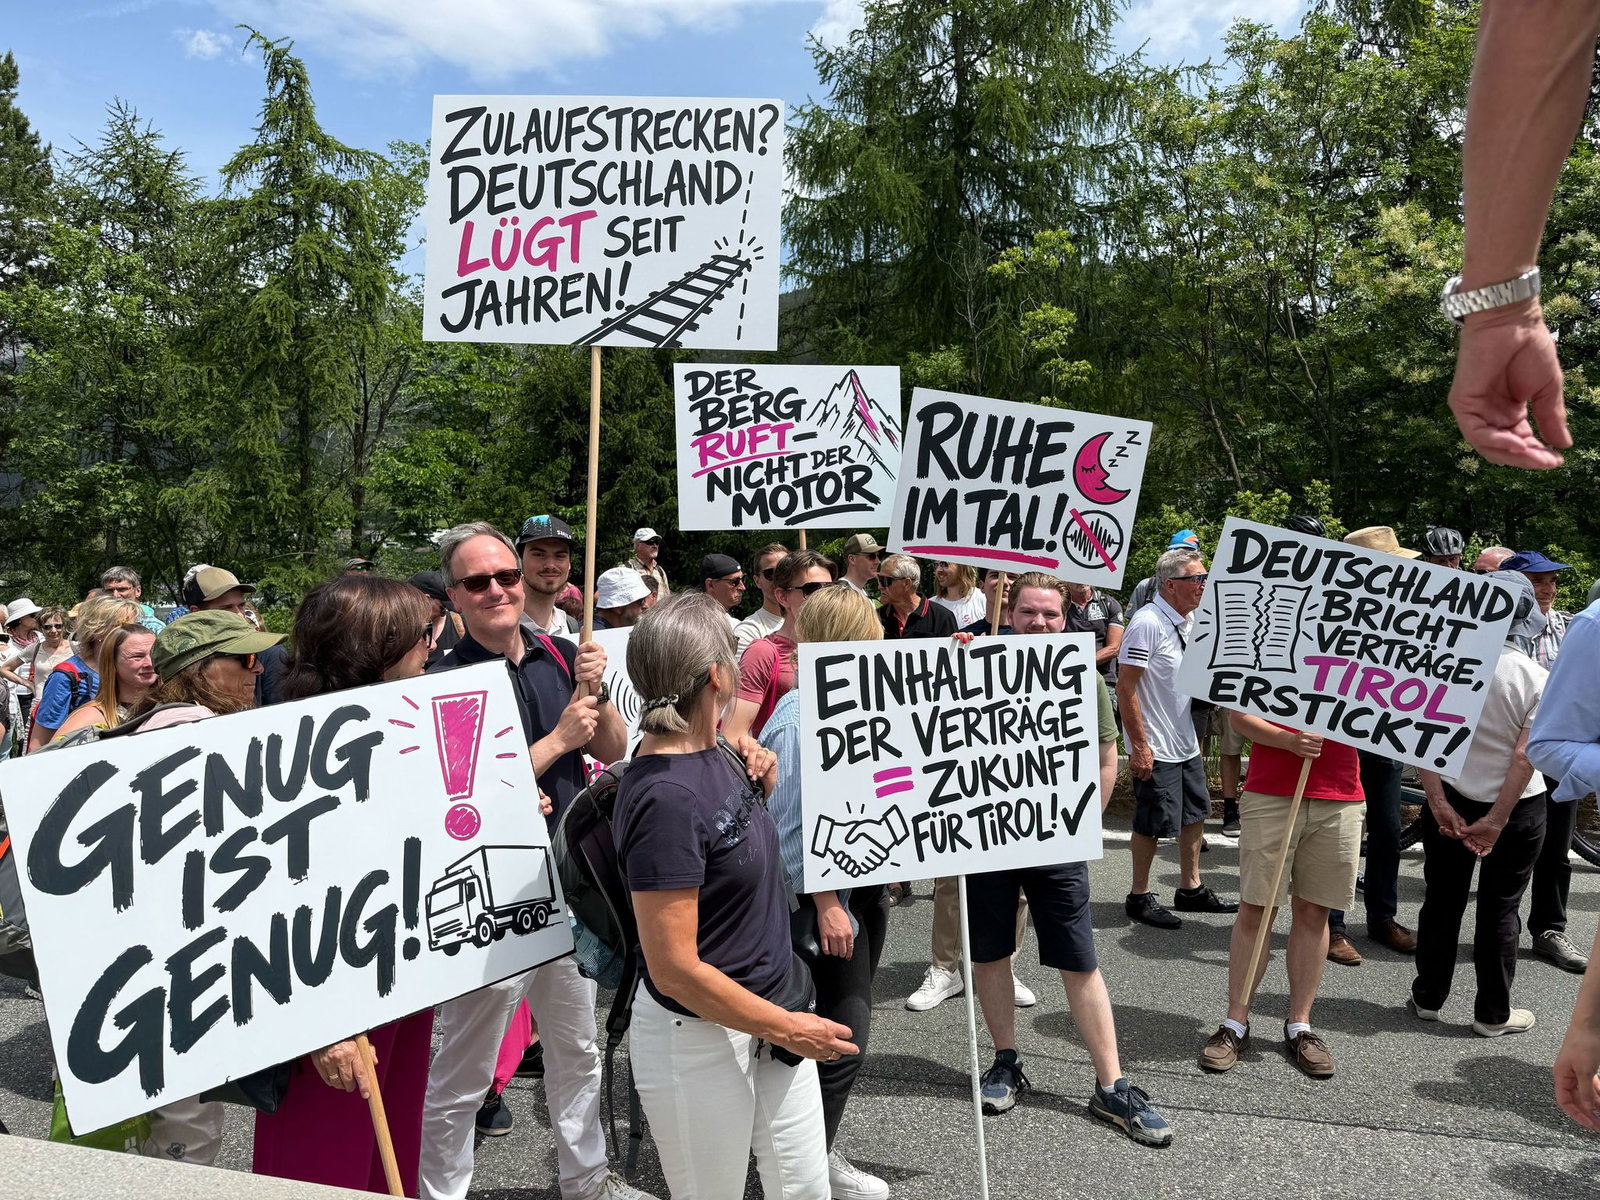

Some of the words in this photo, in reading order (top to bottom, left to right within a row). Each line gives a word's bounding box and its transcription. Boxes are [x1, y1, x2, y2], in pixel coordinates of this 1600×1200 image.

[440, 104, 780, 165] ZULAUFSTRECKEN?
[447, 158, 743, 224] DEUTSCHLAND
[456, 210, 598, 277] LÜGT
[604, 215, 685, 258] SEIT
[440, 261, 632, 333] JAHREN!
[684, 368, 763, 402] DER
[688, 386, 807, 437] BERG
[706, 453, 808, 502] NICHT
[812, 445, 855, 470] DER
[916, 401, 1076, 488] RUHE
[731, 464, 882, 527] MOTOR
[902, 486, 959, 542] IM
[964, 488, 1070, 553] TAL!
[1226, 529, 1515, 623] DEUTSCHLAND
[1320, 590, 1478, 649] BRICHT
[815, 644, 1088, 720] EINHALTUNG
[1303, 655, 1466, 725] TIROL
[1317, 622, 1485, 693] VERTRÄGE,
[816, 716, 903, 772] DER
[911, 697, 1084, 757] VERTRÄGE
[1207, 671, 1472, 769] ERSTICKT!
[27, 704, 384, 913] GENUG
[922, 740, 1090, 808] ZUKUNFT
[182, 795, 342, 932] IST
[911, 811, 973, 863] FÜR
[67, 836, 422, 1098] GENUG!
